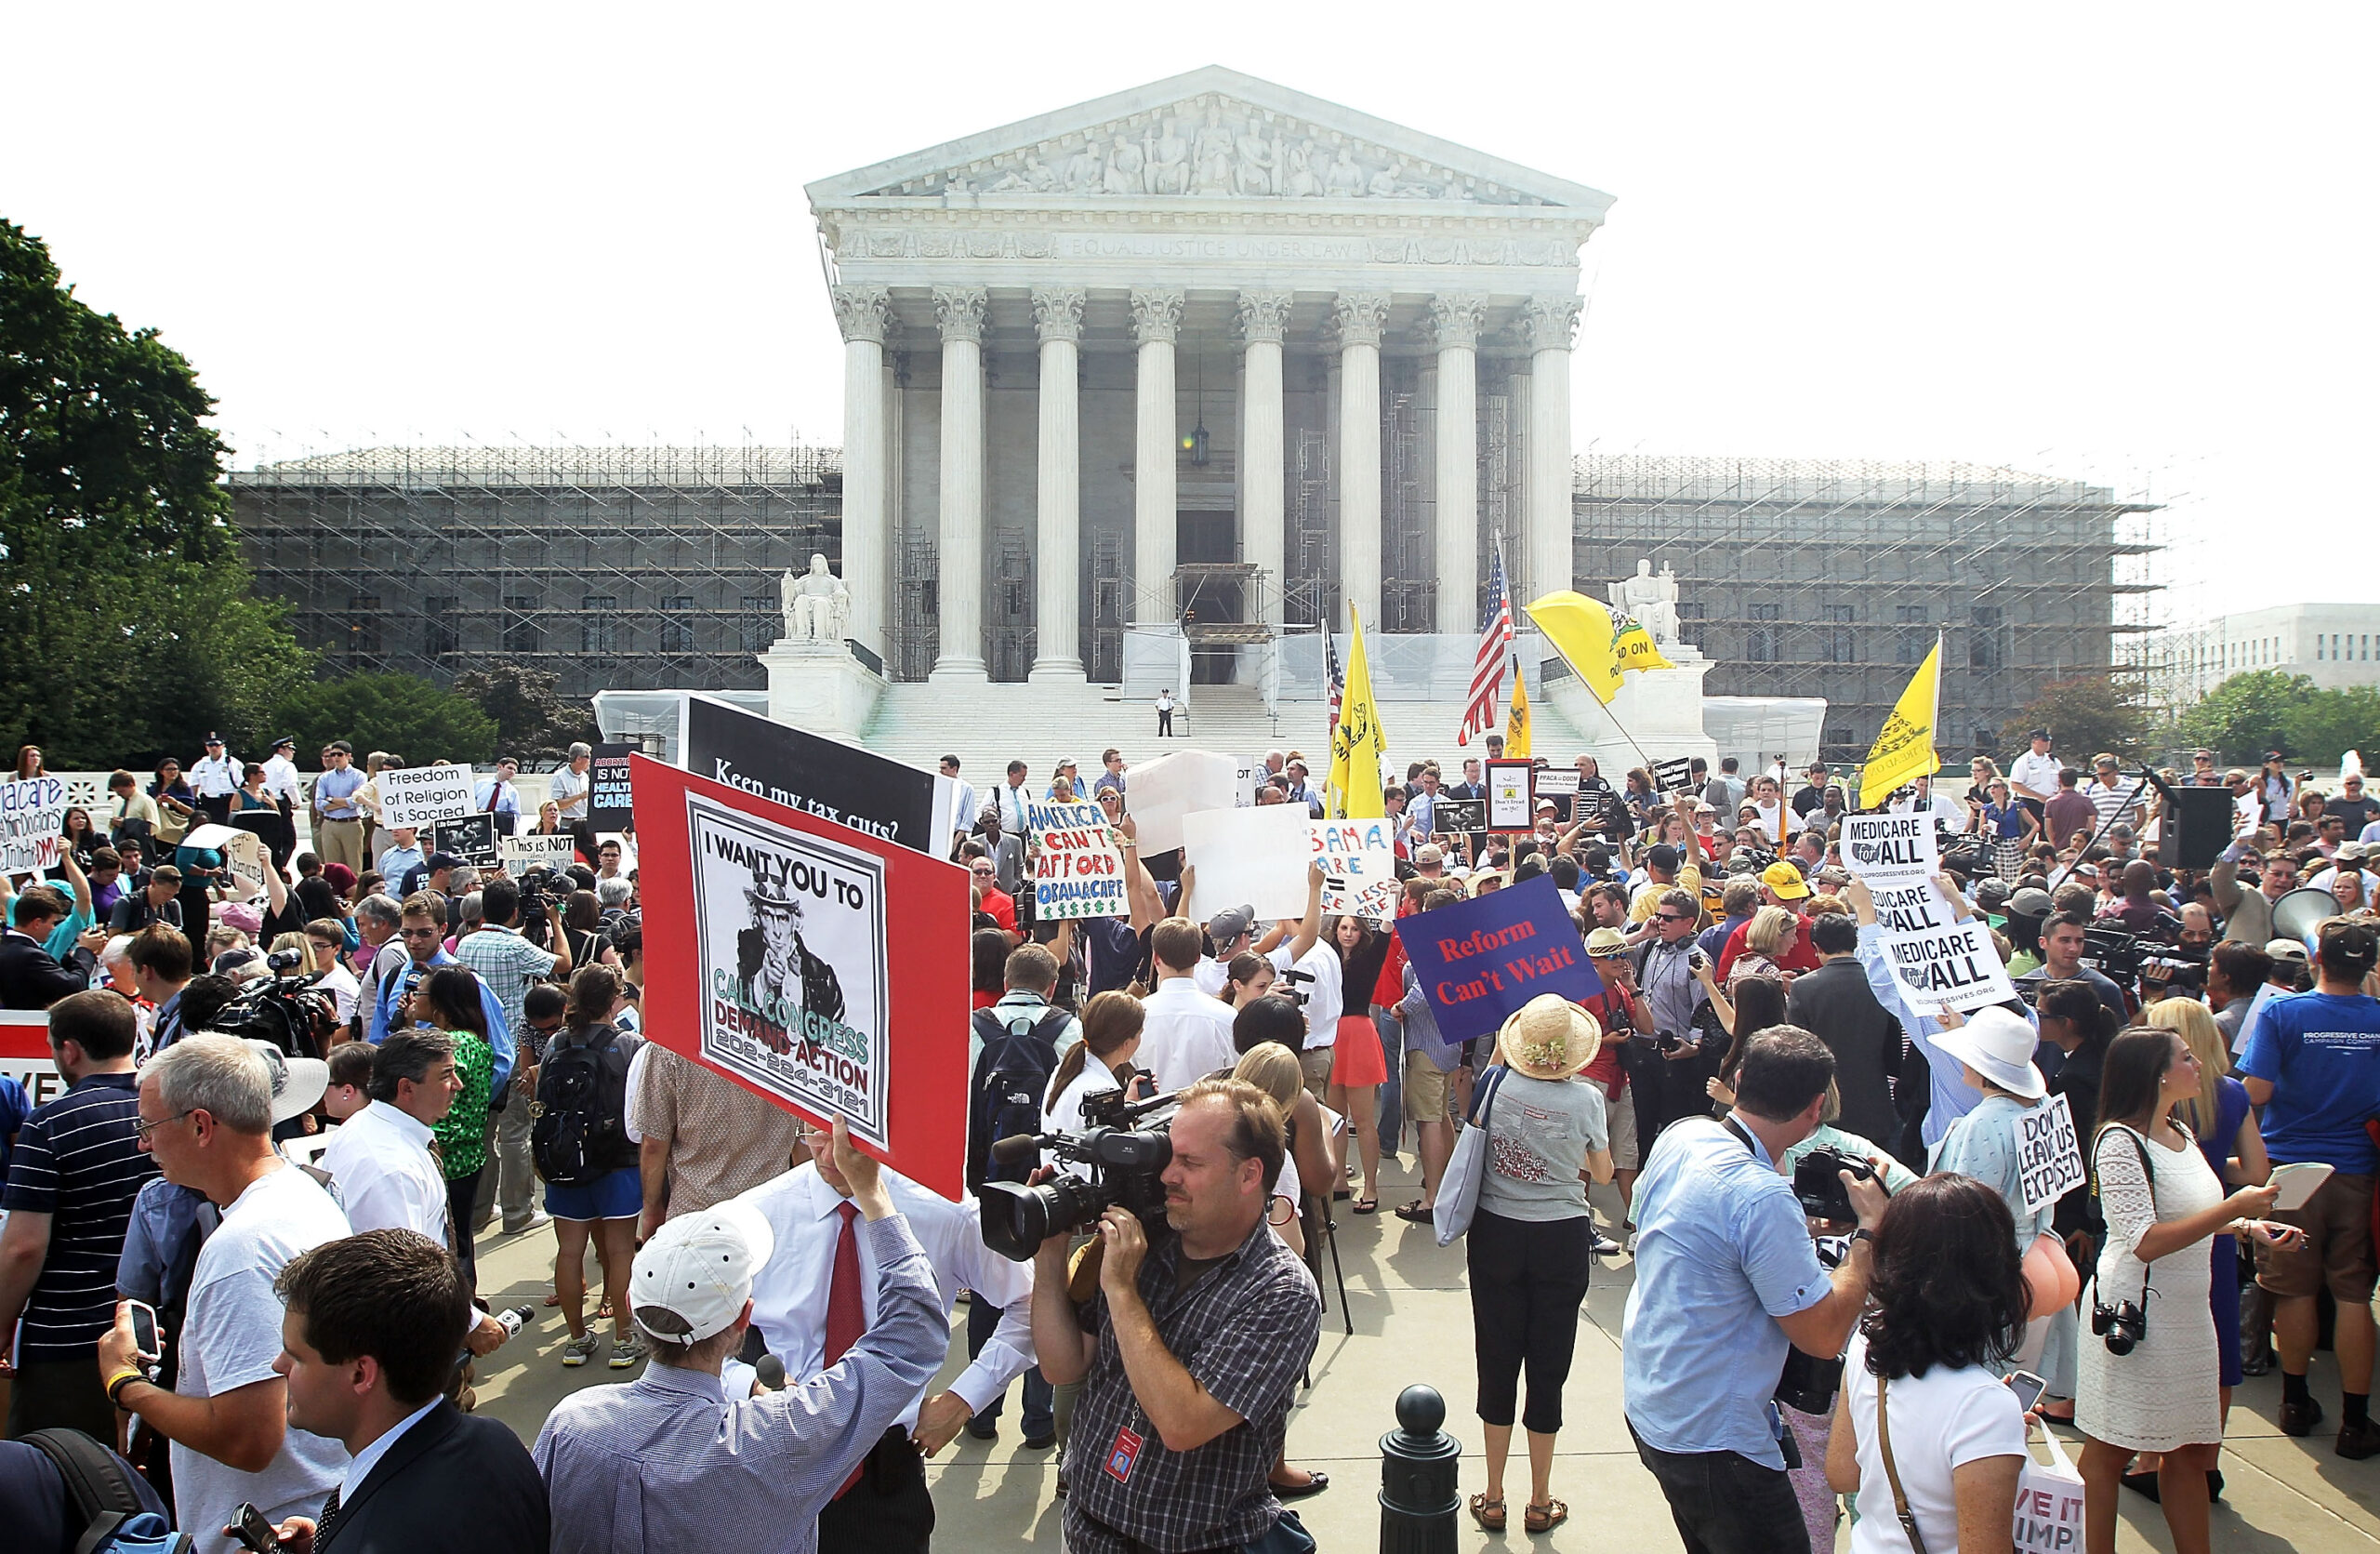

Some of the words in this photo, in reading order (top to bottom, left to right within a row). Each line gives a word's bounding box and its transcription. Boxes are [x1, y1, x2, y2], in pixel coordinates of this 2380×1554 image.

[1072, 239, 1142, 256] EQUAL
[1145, 240, 1227, 257] JUSTICE
[1237, 241, 1302, 258] UNDER
[1312, 242, 1352, 258] LAW
[1632, 642, 1648, 655] ON
[1333, 741, 1351, 763] ONT
[389, 769, 459, 785] Freedom
[598, 769, 608, 780] IS
[1237, 769, 1251, 779] OT
[0, 778, 63, 814] acare
[385, 792, 400, 805] of
[404, 789, 468, 804] Religion
[593, 793, 633, 808] CARE
[715, 757, 764, 797] Keep
[771, 786, 802, 808] my
[807, 797, 840, 822] tax
[847, 814, 899, 841] cuts?
[392, 811, 403, 823] Is
[408, 805, 465, 821] Sacred
[1028, 804, 1106, 830] AMERICA
[1045, 829, 1106, 850] CAN'T
[1311, 824, 1387, 853] BAMA
[1850, 819, 1921, 840] MEDICARE
[507, 837, 533, 852] This
[536, 837, 545, 852] is
[548, 837, 574, 852] NOT
[1858, 843, 1876, 860] for
[1881, 839, 1924, 866] ALL
[705, 830, 711, 854] I
[714, 834, 772, 877] WANT
[774, 854, 827, 898] YOU
[834, 878, 864, 910] TO
[1037, 853, 1116, 878] AFFORD
[1316, 856, 1364, 875] ARE
[1859, 869, 1925, 879] OLDPROGRESSIVES.ORG
[1037, 879, 1123, 905] OBAMACARE
[1354, 881, 1388, 905] LESS
[1870, 885, 1931, 908] EDICARE
[1356, 897, 1389, 917] CARE
[1892, 906, 1940, 932] ALL
[1436, 920, 1537, 963] Reform
[1890, 931, 1979, 964] MEDICARE
[1436, 969, 1505, 1005] Can't
[1504, 945, 1575, 984] Wait
[1906, 970, 1924, 986] for
[1931, 955, 1990, 991] ALL
[713, 968, 760, 1015] CALL
[763, 992, 868, 1065] CONGRESS
[715, 1000, 791, 1056] DEMAND
[796, 1040, 868, 1096] ACTION
[716, 1028, 868, 1118] 202-224-3121
[2024, 1099, 2066, 1142] DON'T
[2056, 1123, 2074, 1153] US
